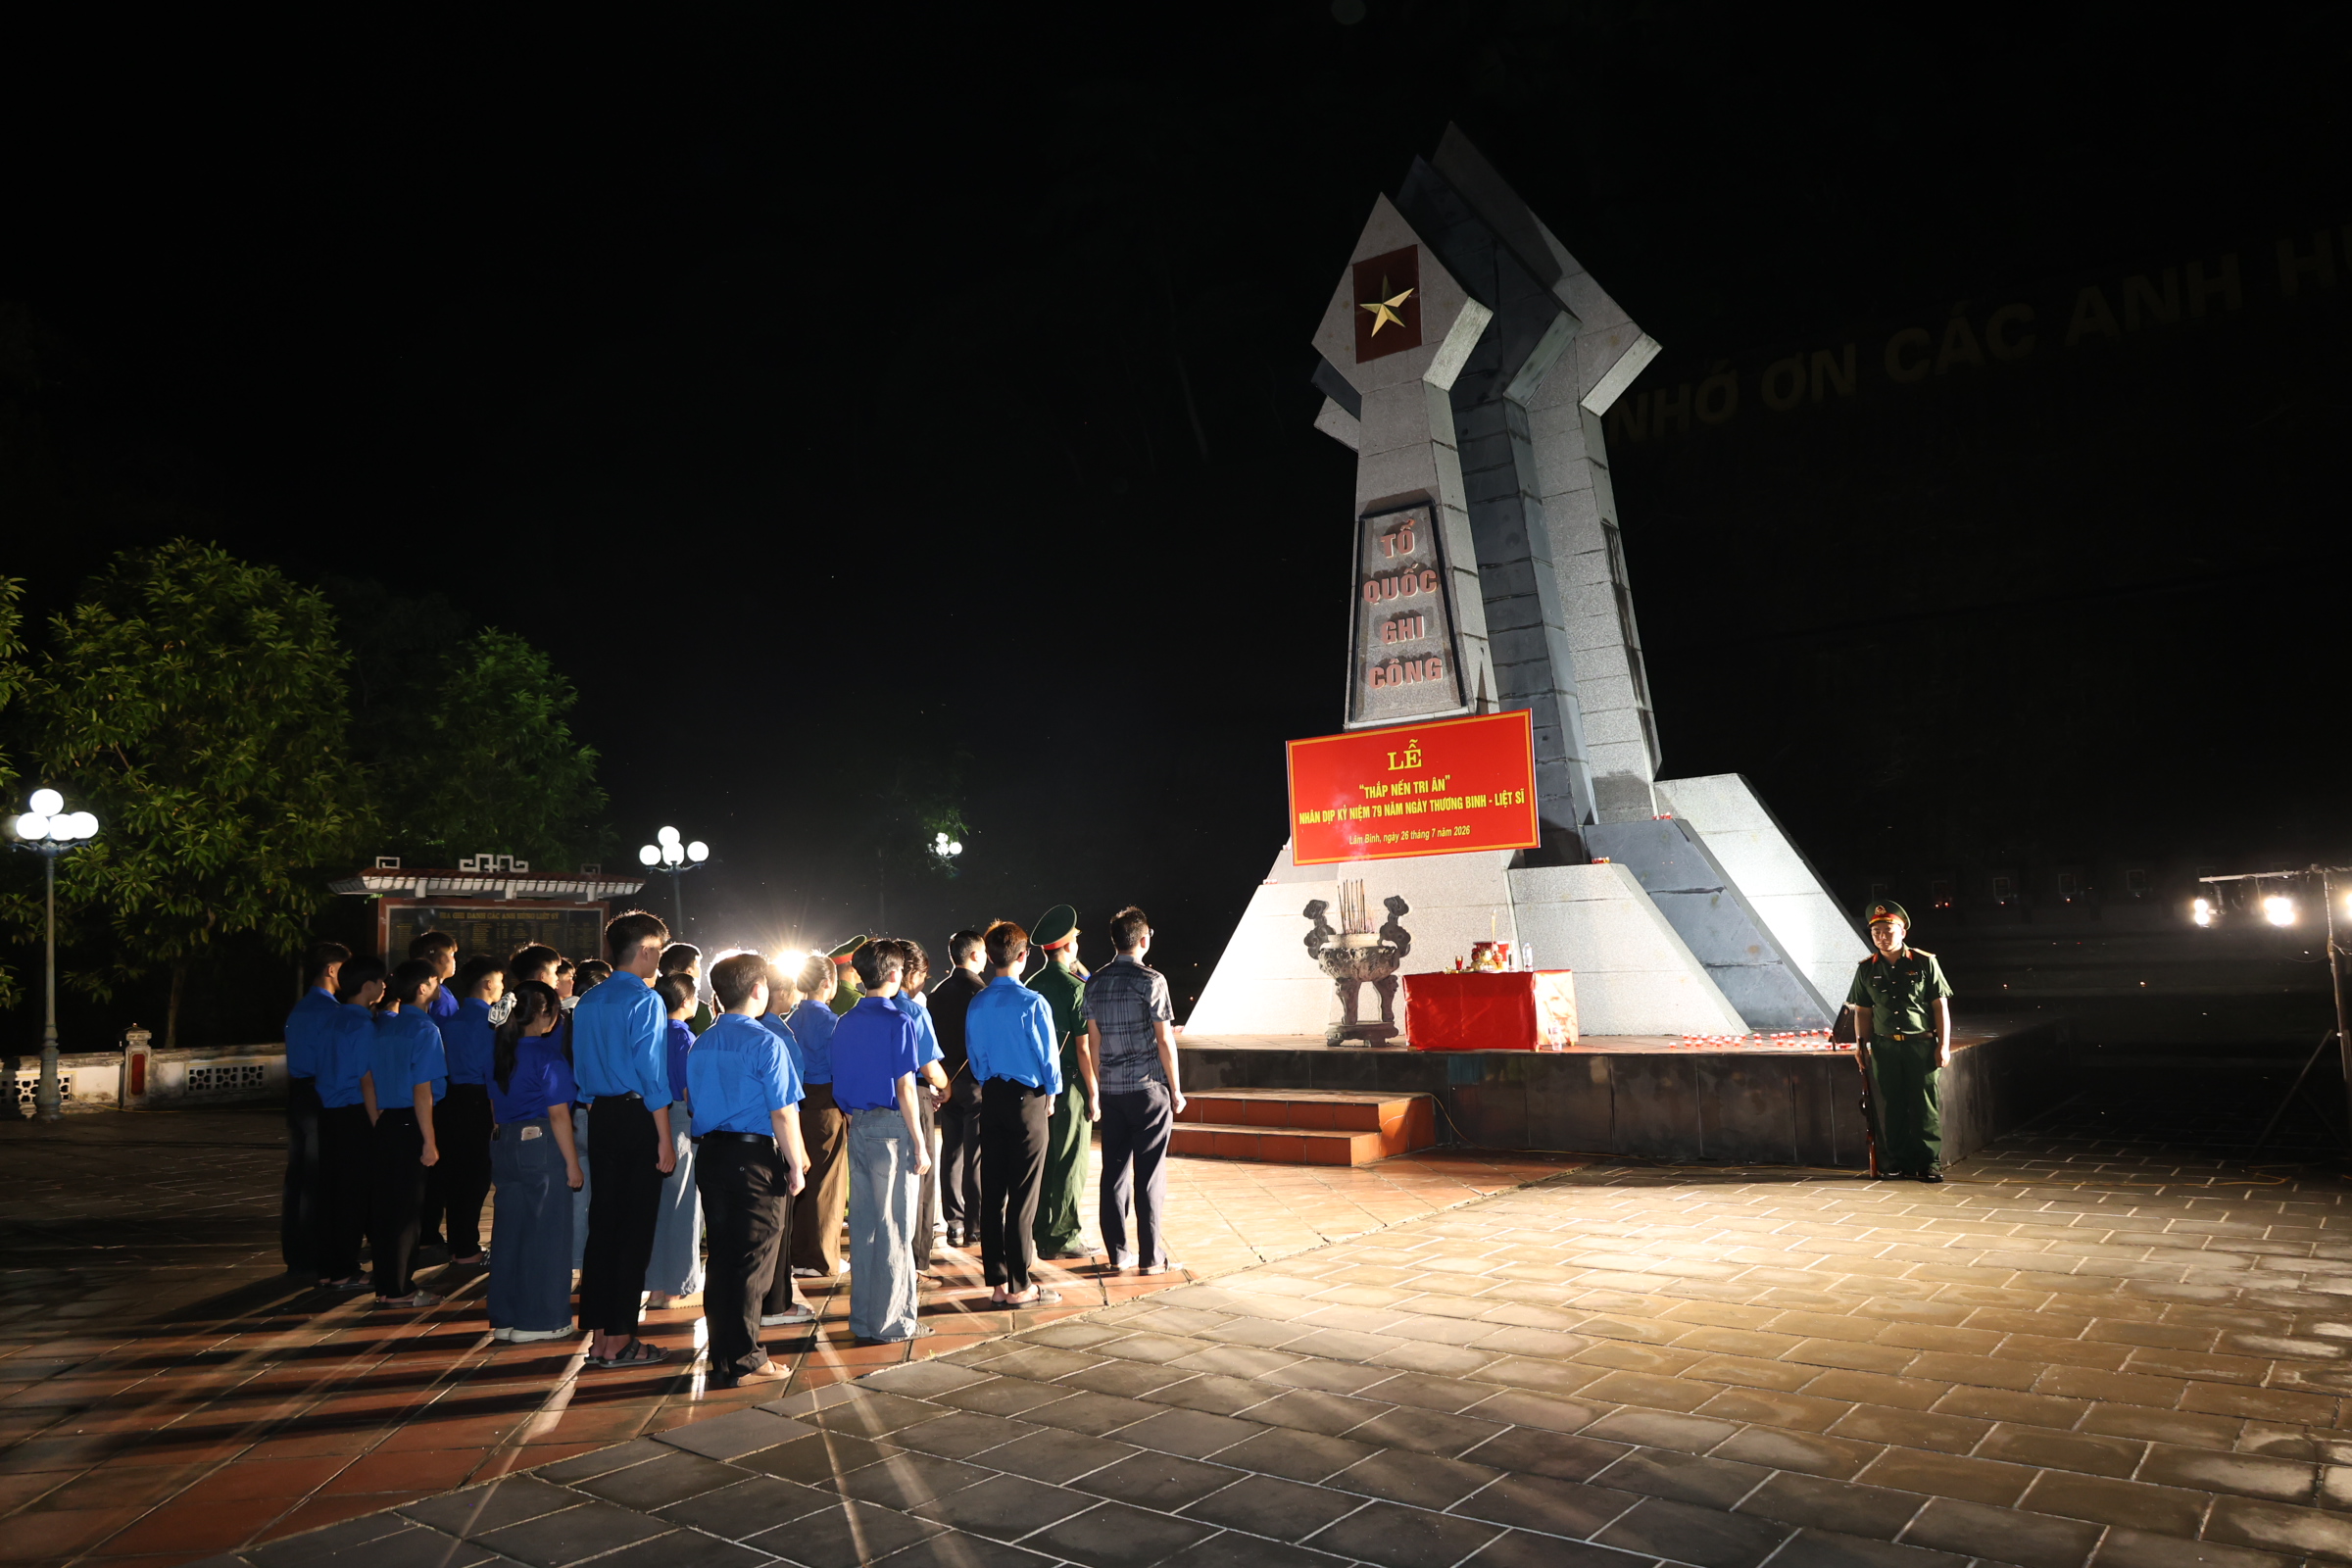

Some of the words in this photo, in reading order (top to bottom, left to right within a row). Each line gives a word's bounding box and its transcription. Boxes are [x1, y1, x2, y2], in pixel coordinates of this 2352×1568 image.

[1608, 358, 1740, 447] NHỚ
[1760, 342, 1857, 413] ƠN
[1883, 299, 2037, 383] CÁC
[2063, 252, 2242, 346] ANH
[1363, 563, 1438, 605] QUỐC
[1381, 615, 1425, 645] GHI
[1368, 658, 1444, 689] CÔNG
[1387, 739, 1422, 771] LỄ
[1391, 779, 1411, 796] NẾN
[1413, 780, 1429, 794] TRI
[1298, 809, 1321, 824] NHÂN
[1322, 809, 1336, 824] DỊP
[1349, 805, 1370, 821] NIỆM
[1372, 805, 1383, 818] 79
[1384, 801, 1403, 816] NĂM
[1405, 799, 1428, 814] NGÀY
[1430, 797, 1464, 812] THƯƠNG
[1465, 795, 1487, 808] BINH
[1494, 790, 1513, 808] LIỆT
[1515, 788, 1525, 804] SĨ
[1383, 832, 1399, 844] ngày
[1400, 830, 1409, 840] 26
[1410, 829, 1430, 841] tháng
[1432, 828, 1436, 838] 7
[1437, 827, 1452, 837] năm
[1453, 825, 1471, 836] 2026
